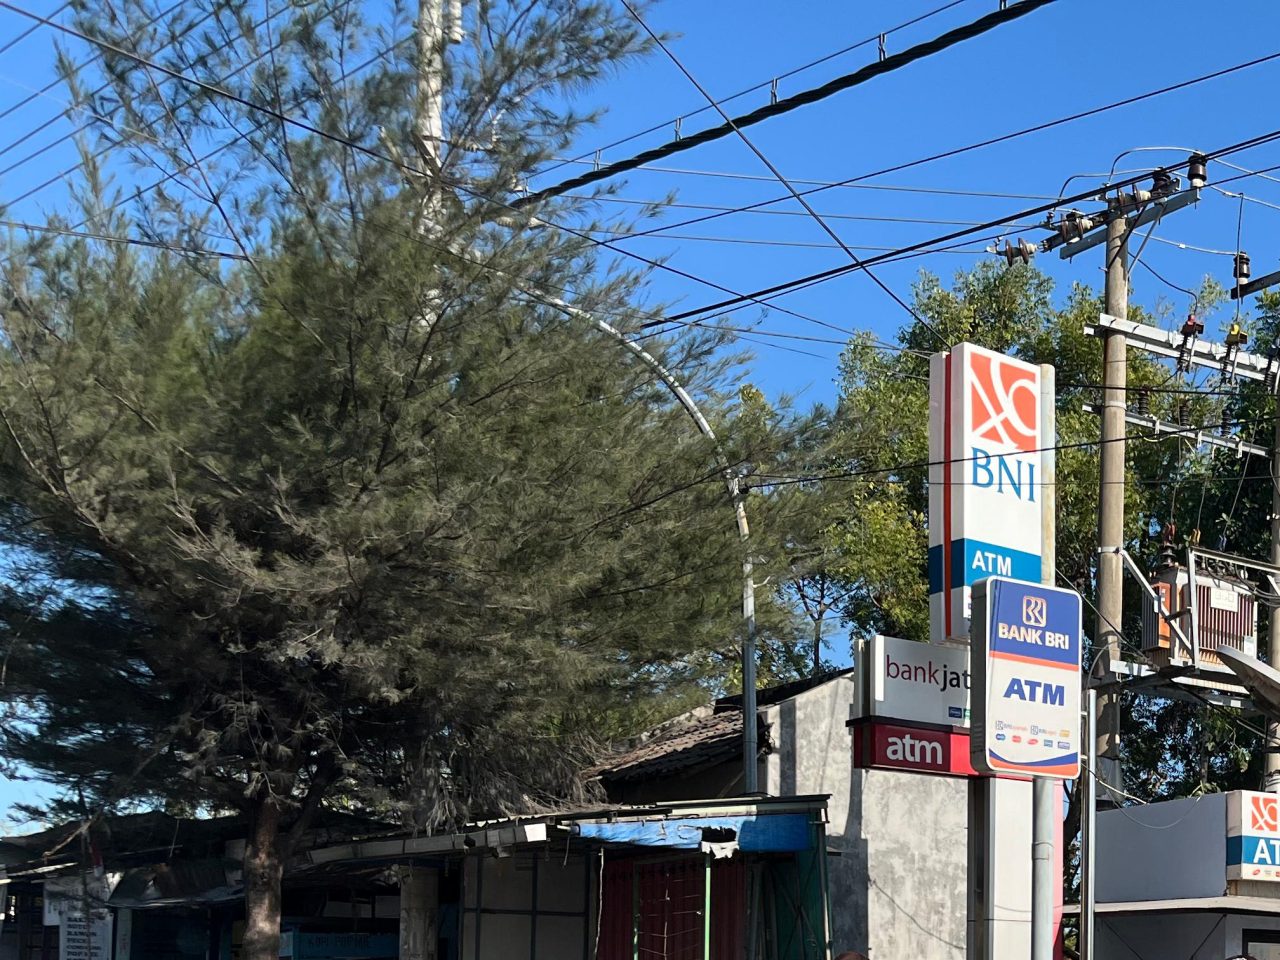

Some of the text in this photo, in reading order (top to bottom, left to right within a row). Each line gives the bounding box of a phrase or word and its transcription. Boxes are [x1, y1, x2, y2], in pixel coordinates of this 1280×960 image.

[971, 446, 1035, 503] BNI
[972, 550, 1012, 577] ATM
[998, 622, 1069, 650] BANK BRI
[886, 654, 971, 692] bankjat
[1003, 677, 1065, 706] ATM
[886, 734, 943, 765] atm
